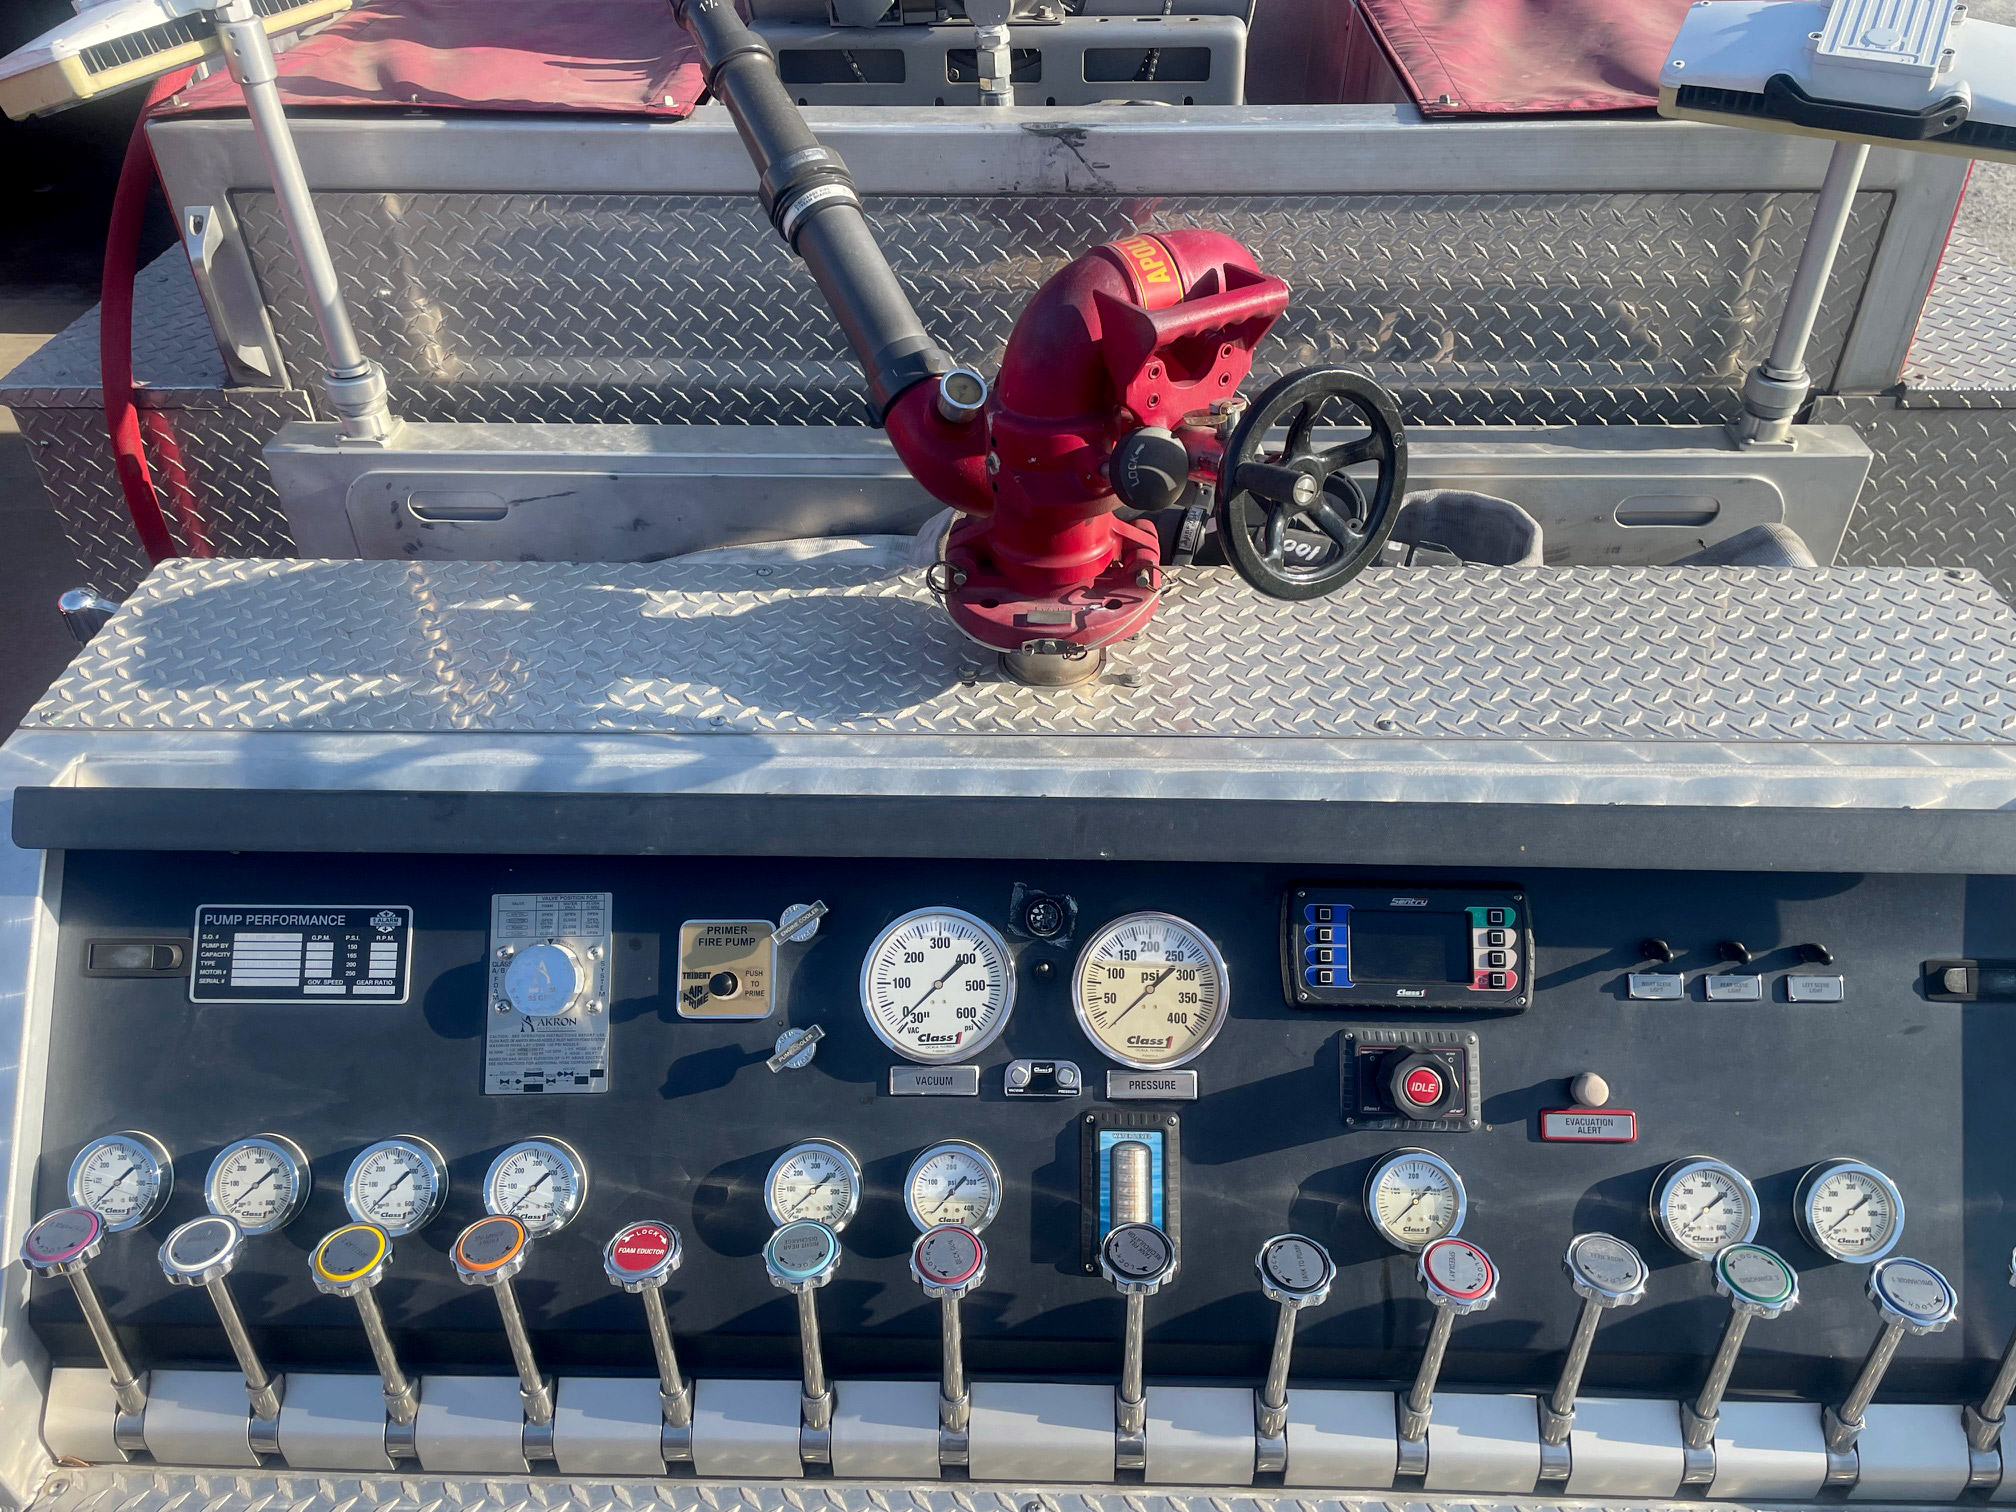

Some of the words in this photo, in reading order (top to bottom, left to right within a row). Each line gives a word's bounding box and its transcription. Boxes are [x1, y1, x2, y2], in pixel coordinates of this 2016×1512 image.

[1128, 454, 1140, 487] LOCK
[1284, 540, 1321, 560] 100
[1390, 898, 1428, 907] Sentry
[204, 915, 242, 925] PUMP
[246, 915, 346, 926] PERFORMANCE
[780, 922, 799, 937] ENGINE
[799, 908, 819, 923] COOLER
[726, 938, 755, 946] PUMP
[930, 937, 950, 949] 300
[1141, 941, 1160, 952] 200
[904, 952, 924, 963] 200
[956, 954, 976, 964] 400
[1119, 950, 1136, 961] 150
[1165, 951, 1184, 962] 250
[1106, 968, 1124, 979] 100
[1141, 970, 1160, 983] psi
[1176, 970, 1195, 981] 300
[892, 978, 911, 988] 100
[966, 980, 985, 991] 500
[689, 986, 703, 998] AIR
[1396, 989, 1426, 997] Class1
[684, 993, 709, 1010] PRIME
[1104, 993, 1116, 1004] 50
[1179, 993, 1198, 1003] 350
[910, 1012, 930, 1023] 30"
[957, 1007, 976, 1018] 600
[537, 1018, 577, 1026] AKRON
[1167, 1013, 1187, 1024] 400
[965, 1024, 974, 1032] psi
[918, 1032, 962, 1044] Class1
[1127, 1036, 1173, 1049] Class1
[916, 1076, 953, 1085] VACUUM
[1129, 1081, 1176, 1090] PRESSURE
[1411, 1082, 1436, 1092] IDLE
[1565, 1118, 1613, 1126] EVACUATION
[1578, 1126, 1602, 1135] ALERT
[784, 1236, 818, 1244] DISCHARGE
[1128, 1231, 1162, 1260] RECIRCULATOR
[1139, 1247, 1152, 1260] TANK
[1294, 1244, 1303, 1259] PUMP
[324, 1260, 341, 1272] LOCK
[926, 1252, 937, 1271] LOCK
[1117, 1254, 1135, 1270] LOCK
[1271, 1255, 1281, 1274] LOCK
[1301, 1269, 1309, 1282] TANK
[1475, 1262, 1483, 1283] LOCK
[1900, 1277, 1933, 1286] DISCHARGE
[1908, 1301, 1937, 1310] LOCK
